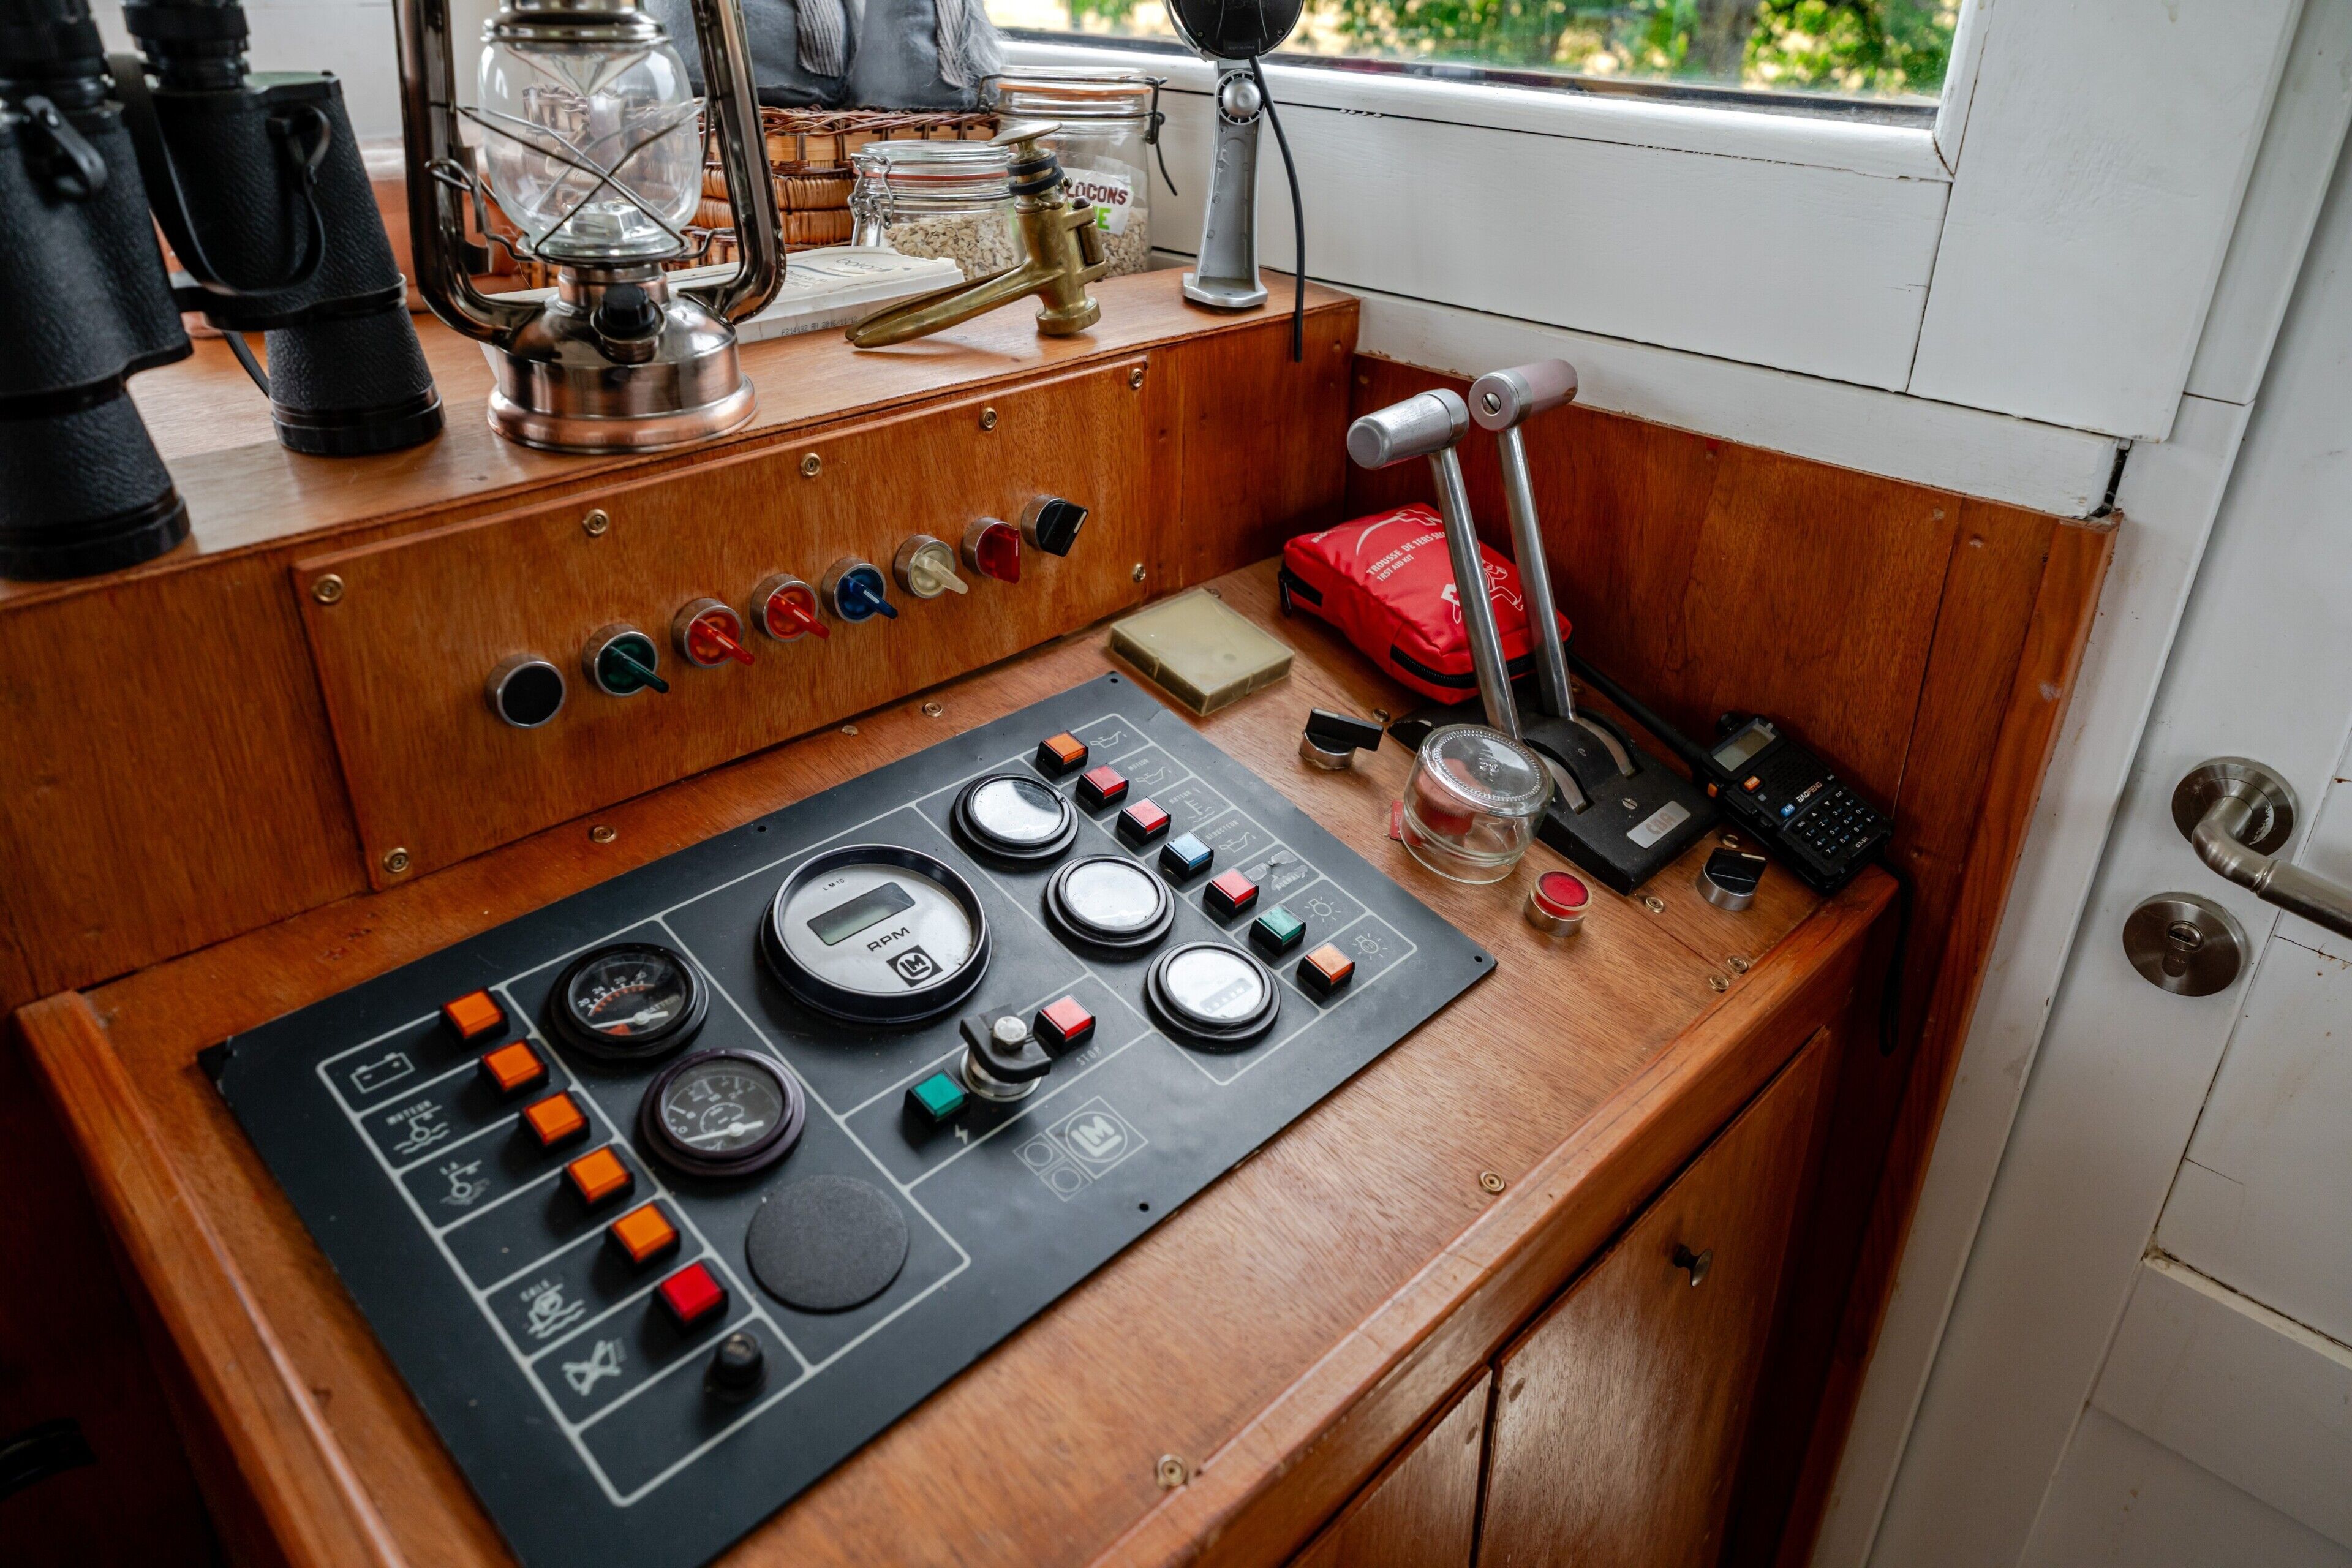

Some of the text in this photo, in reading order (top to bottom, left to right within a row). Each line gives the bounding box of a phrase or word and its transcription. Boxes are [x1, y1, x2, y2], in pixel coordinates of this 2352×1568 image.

[1065, 181, 1128, 205] LOCONS
[1366, 531, 1446, 576] TROUSSE DE 1ERS SEC
[1376, 554, 1414, 582] 1RST AID KIT
[1796, 781, 1823, 803] BAOFENG
[1784, 804, 1795, 813] A/B
[866, 927, 910, 952] RPM
[1076, 1046, 1101, 1066] STOP
